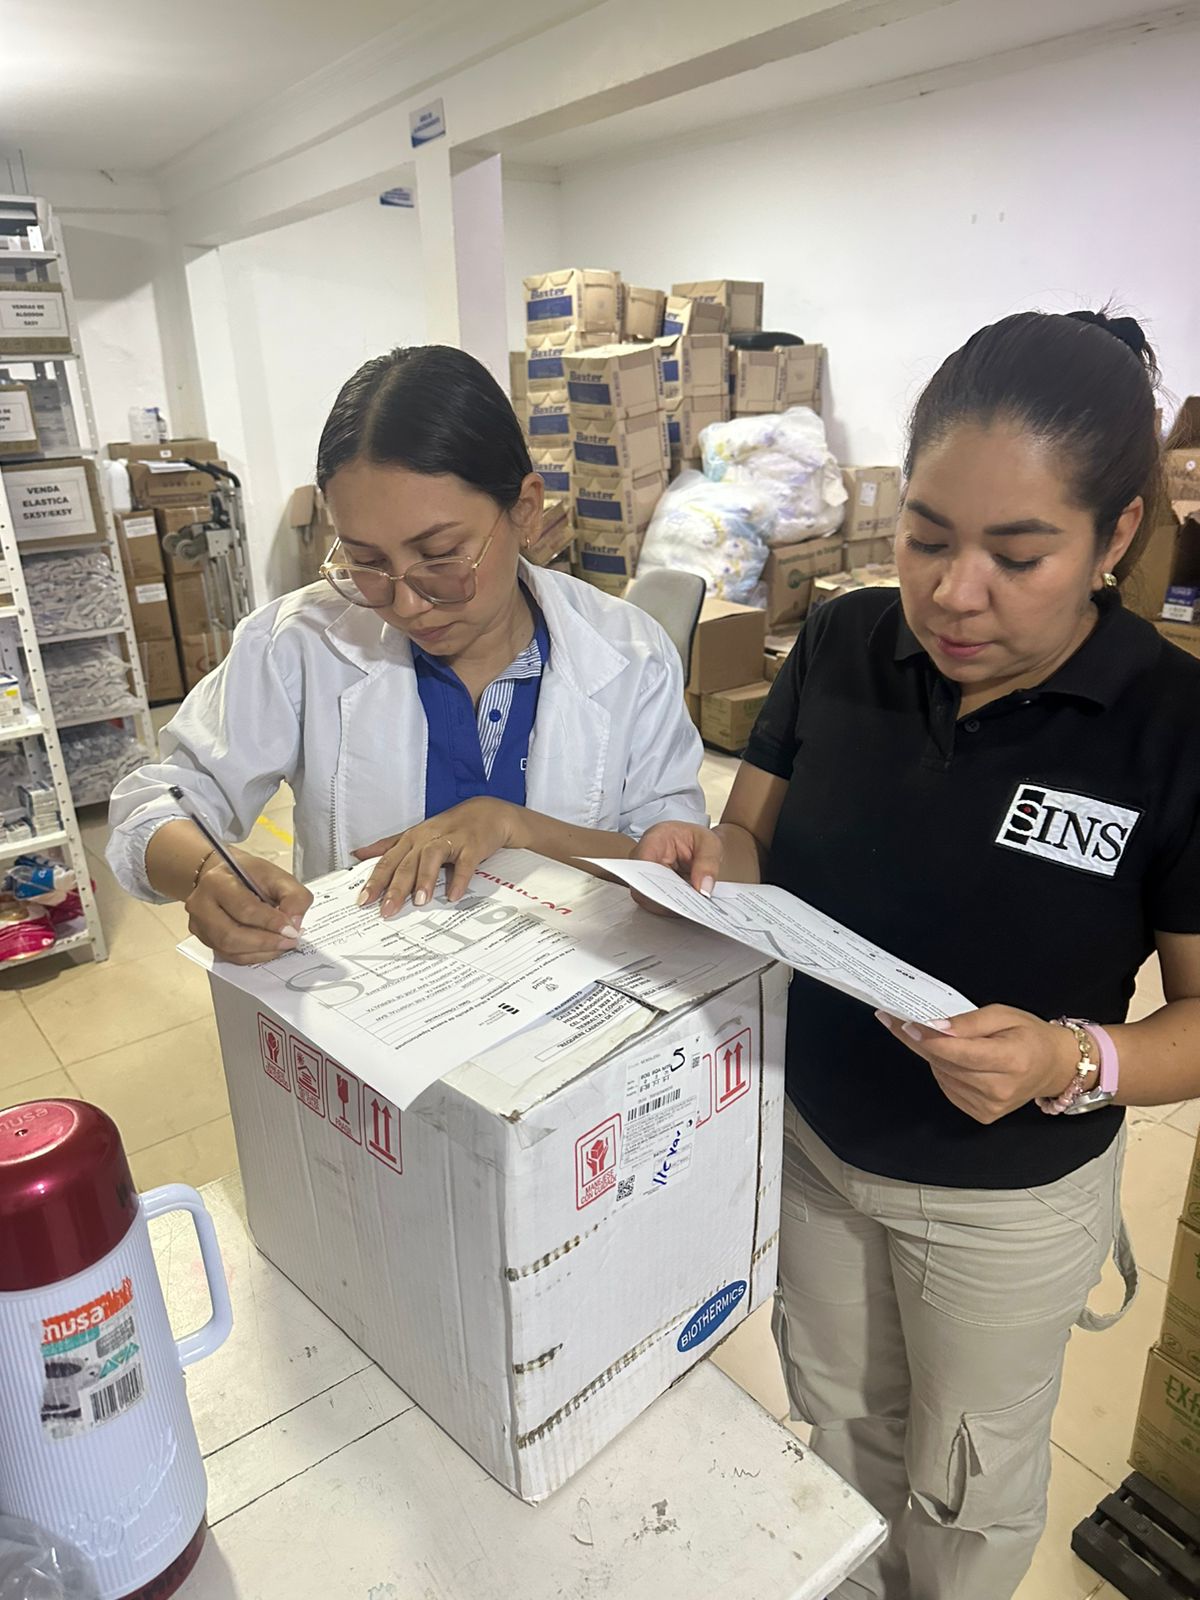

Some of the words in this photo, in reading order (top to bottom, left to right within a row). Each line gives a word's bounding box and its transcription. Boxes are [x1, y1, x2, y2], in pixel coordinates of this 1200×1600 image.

[531, 288, 566, 299] Baxter
[531, 348, 565, 359] Baxter
[569, 370, 603, 383] Baxter
[532, 404, 566, 415] Baxter
[576, 431, 610, 444] Baxter
[26, 484, 60, 495] VENDA
[579, 487, 615, 500] Baxter
[22, 496, 70, 508] ELASTICA
[584, 542, 620, 554] Baxter
[529, 975, 555, 990] Salud
[562, 1008, 585, 1024] HERNÁN
[584, 989, 612, 1011] RODRÍGUEZ
[556, 1010, 572, 1021] CALLE
[575, 1012, 603, 1031] TIERRALTA
[584, 1020, 605, 1035] CADENA
[671, 1046, 686, 1073] 5
[681, 1285, 745, 1348] BIOTHERMICS
